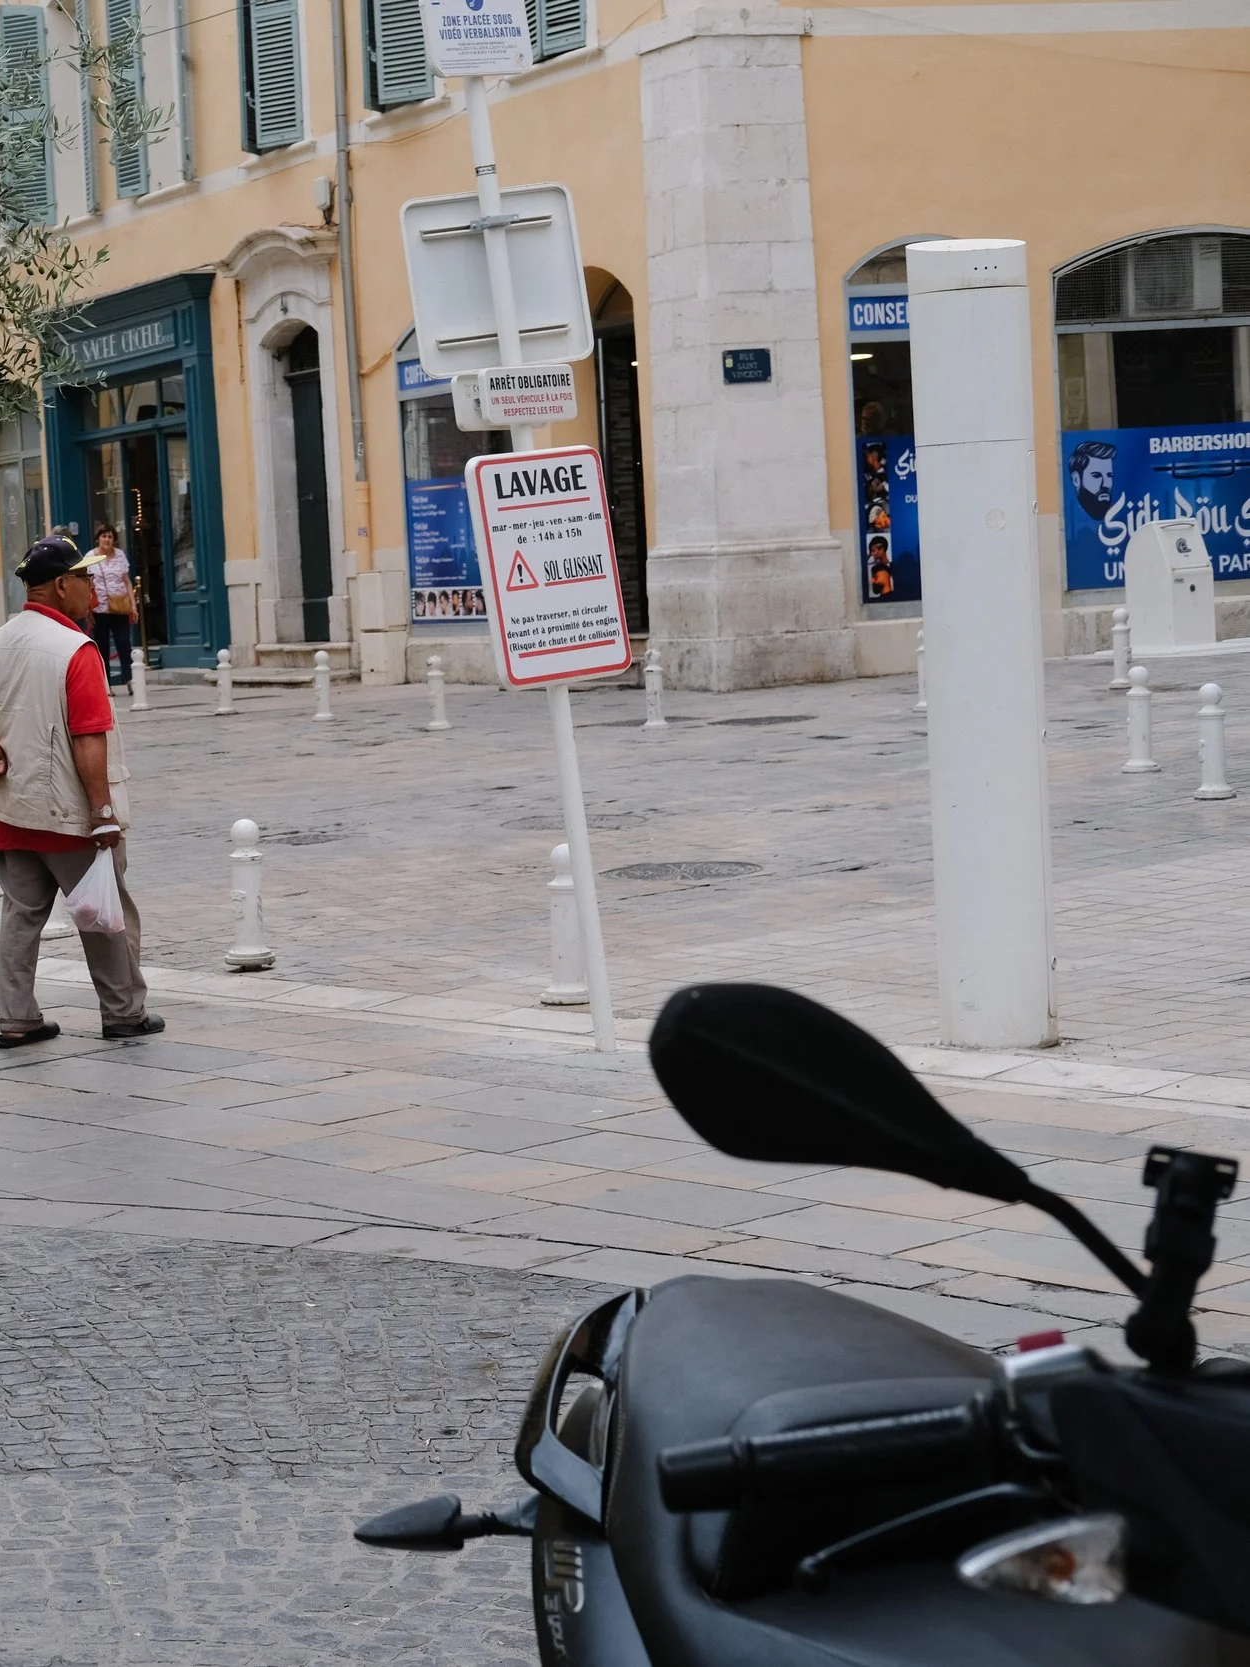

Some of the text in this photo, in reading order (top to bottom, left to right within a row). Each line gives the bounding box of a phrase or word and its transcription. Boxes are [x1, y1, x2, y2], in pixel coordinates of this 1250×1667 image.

[441, 13, 513, 27] ZONE PLACÉE SOUS
[439, 26, 522, 40] VIDÉO VERBALISATION
[739, 353, 755, 361] RUE
[731, 370, 763, 378] VINCENT
[737, 362, 758, 370] SAINT
[490, 373, 571, 391] ARRÊT OBLIGATOIRE
[491, 396, 500, 405] UN
[501, 395, 516, 404] SEUL
[517, 393, 544, 403] VÉHICULE
[551, 394, 558, 402] LA
[560, 392, 573, 401] FOIS
[503, 405, 564, 417] RESPECTEZ LES FEUX
[494, 464, 587, 499] LAVAGE
[1174, 486, 1232, 535] Bou
[517, 534, 527, 544] de
[538, 530, 555, 541] 14h
[557, 529, 563, 539] à
[566, 528, 582, 538] 15h
[543, 554, 605, 582] SOL GLISSANT
[511, 604, 608, 626] Ne pas traverser, ni circuler
[507, 616, 619, 639] devant et à proximité des engins
[509, 628, 620, 654] (Risque de chute et de collision)
